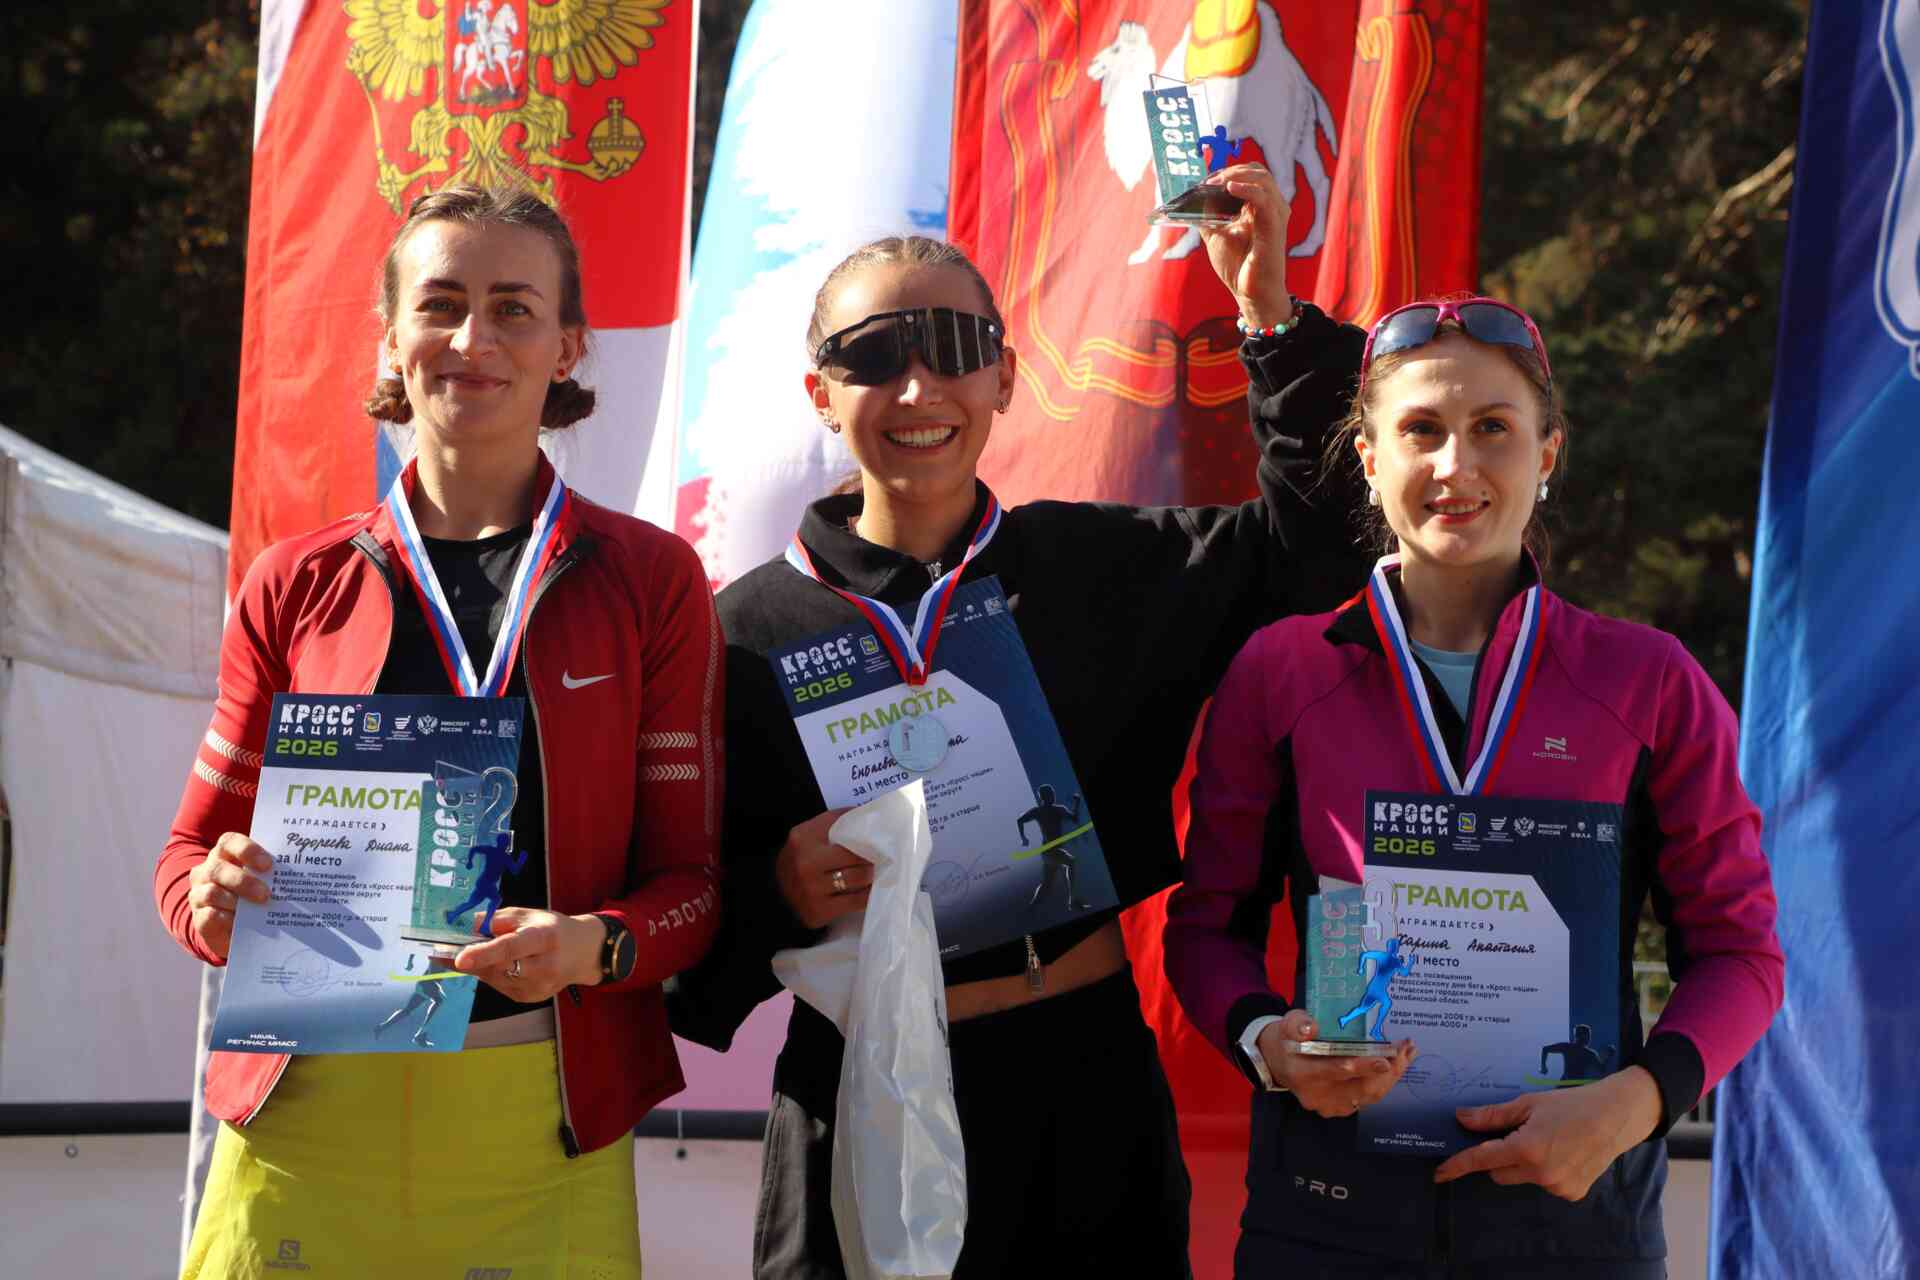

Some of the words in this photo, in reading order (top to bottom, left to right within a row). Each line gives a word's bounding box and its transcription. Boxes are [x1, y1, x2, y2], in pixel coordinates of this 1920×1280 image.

[1156, 97, 1190, 177] КРОСС
[781, 637, 852, 675] КРОСС
[787, 656, 857, 685] НАЦИИ
[793, 672, 853, 703] 2026
[281, 704, 356, 726] КРОСС
[826, 687, 957, 744] ГРАМОТА
[278, 725, 353, 736] НАЦИИ
[275, 739, 339, 756] 2026
[853, 785, 865, 797] за
[875, 771, 910, 787] место
[287, 784, 421, 810] ГРАМОТА
[283, 818, 377, 830] НАГРАЖДАЕТСЯ
[1374, 801, 1449, 825] КРОСС
[430, 791, 463, 888] КРОСС
[1373, 822, 1449, 836] НАЦИИ
[1374, 836, 1436, 856] 2026
[276, 854, 290, 864] за
[305, 856, 342, 867] место
[1393, 882, 1530, 912] ГРАМОТА
[1399, 917, 1485, 930] АГРАЖДАЕТСЯ
[1423, 956, 1460, 967] место
[1295, 1175, 1349, 1200] PRO
